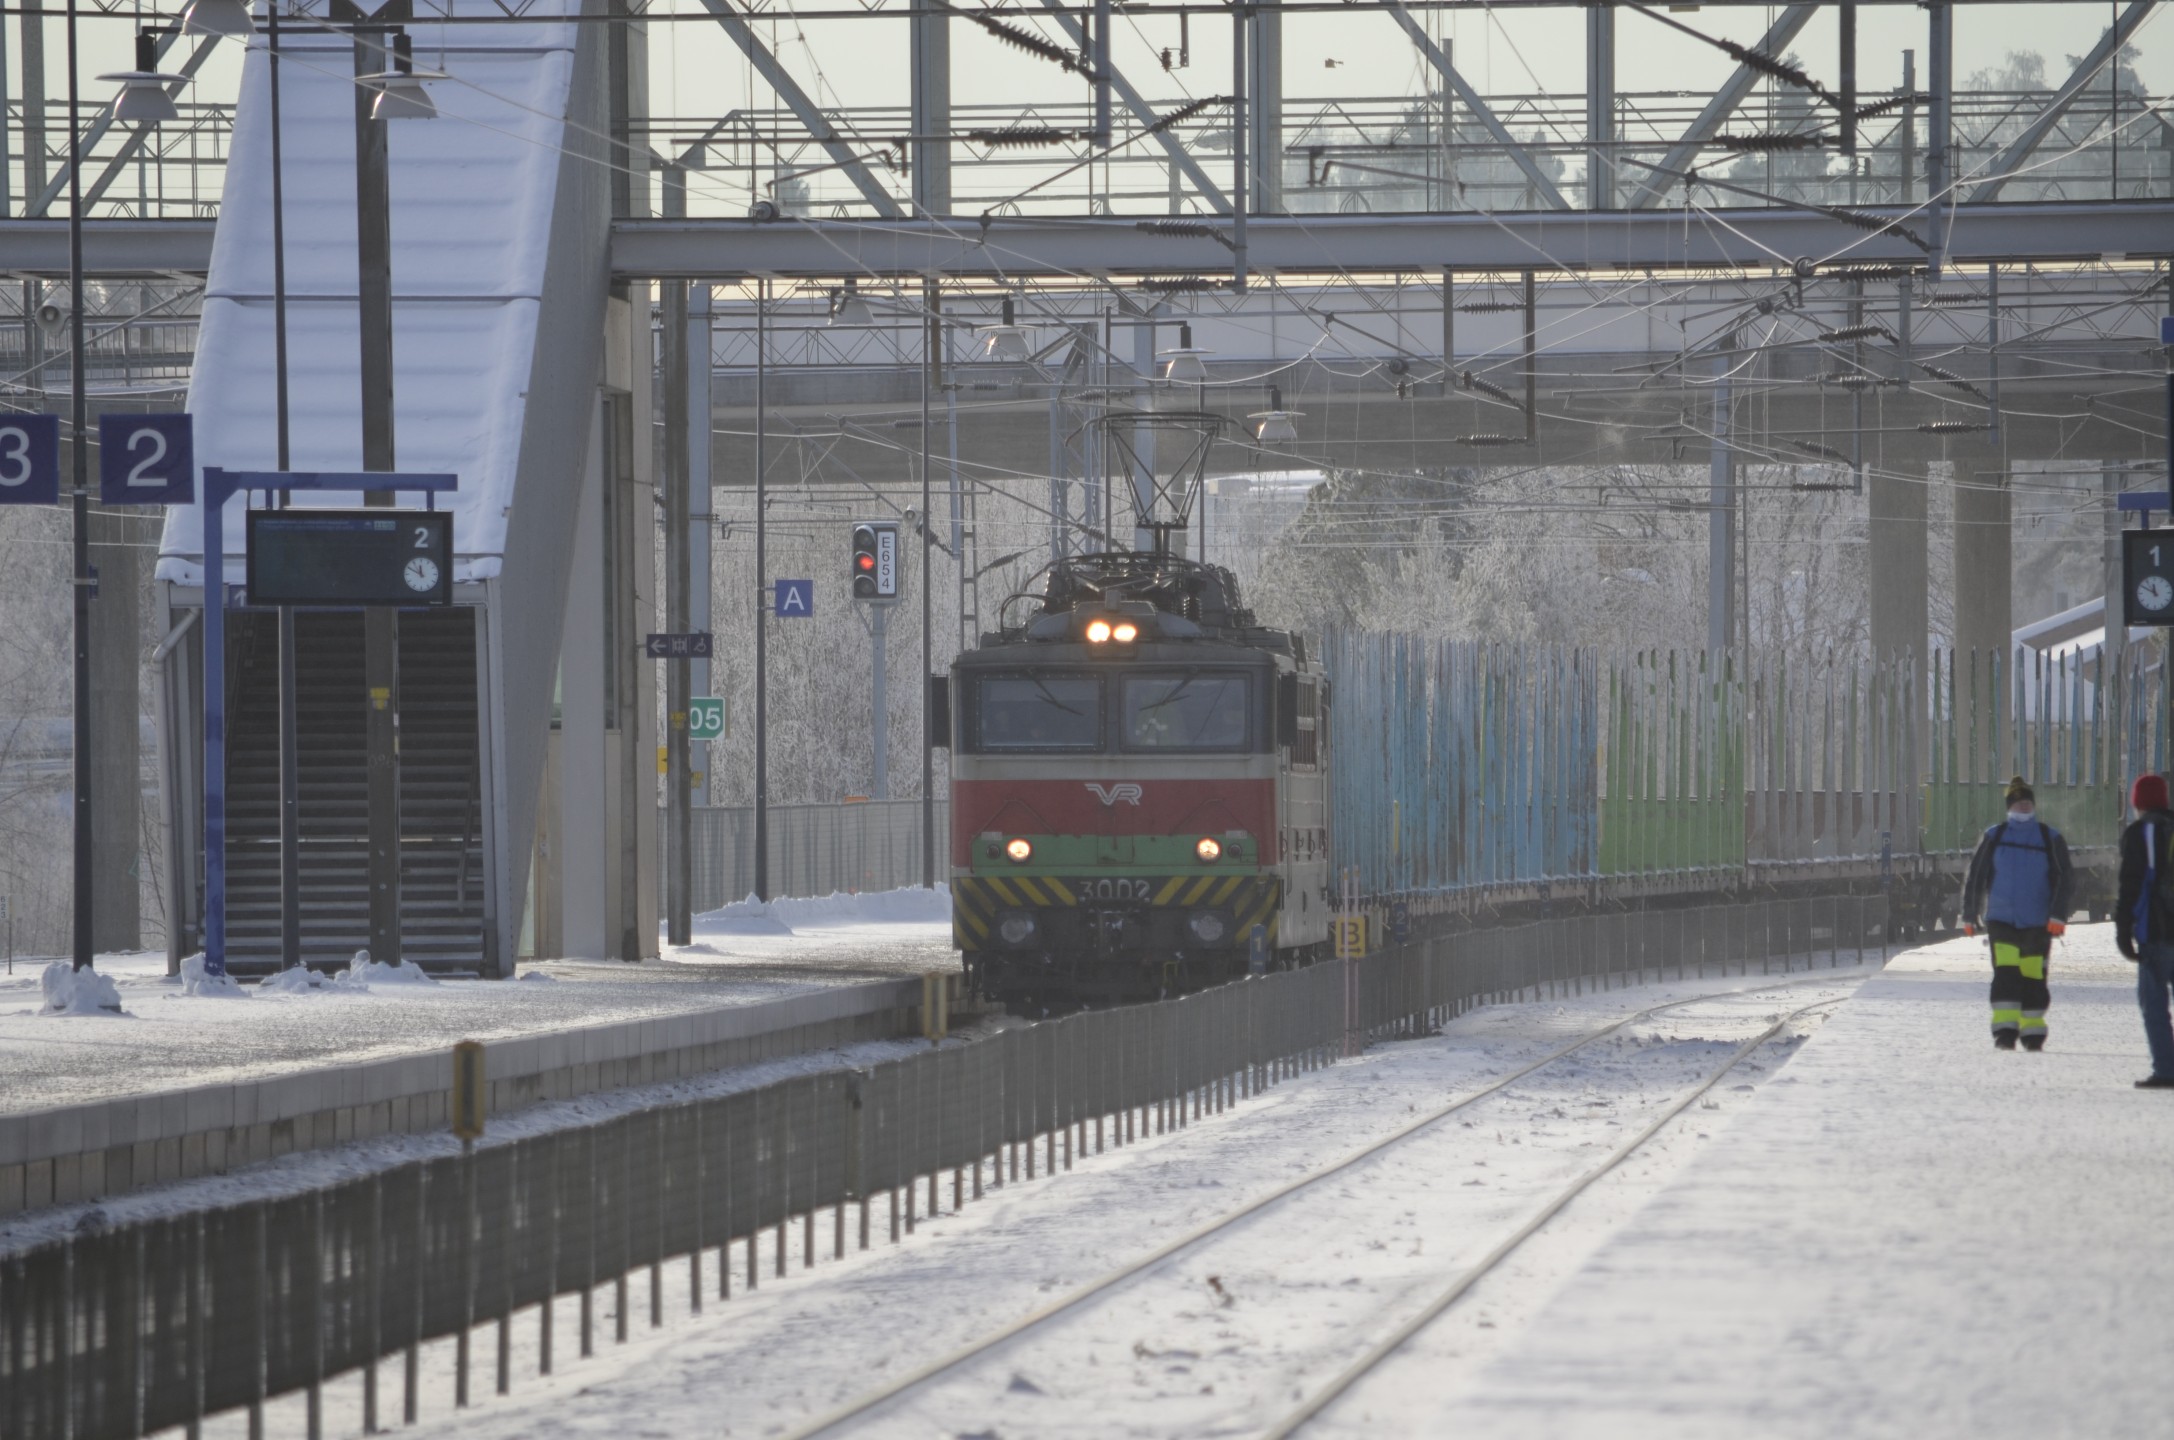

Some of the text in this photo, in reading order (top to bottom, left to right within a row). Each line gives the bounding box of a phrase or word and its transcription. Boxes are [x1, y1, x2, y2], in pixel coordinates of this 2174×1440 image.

[0, 427, 32, 487] 3
[127, 428, 168, 487] 2
[414, 527, 429, 548] 2
[881, 536, 891, 590] E654
[2149, 545, 2160, 567] 1
[783, 586, 805, 611] A
[1085, 783, 1143, 806] VR
[1079, 878, 1150, 898] 3002
[1396, 910, 1406, 925] 2
[1254, 936, 1262, 953] 1
[1341, 921, 1361, 946] B
